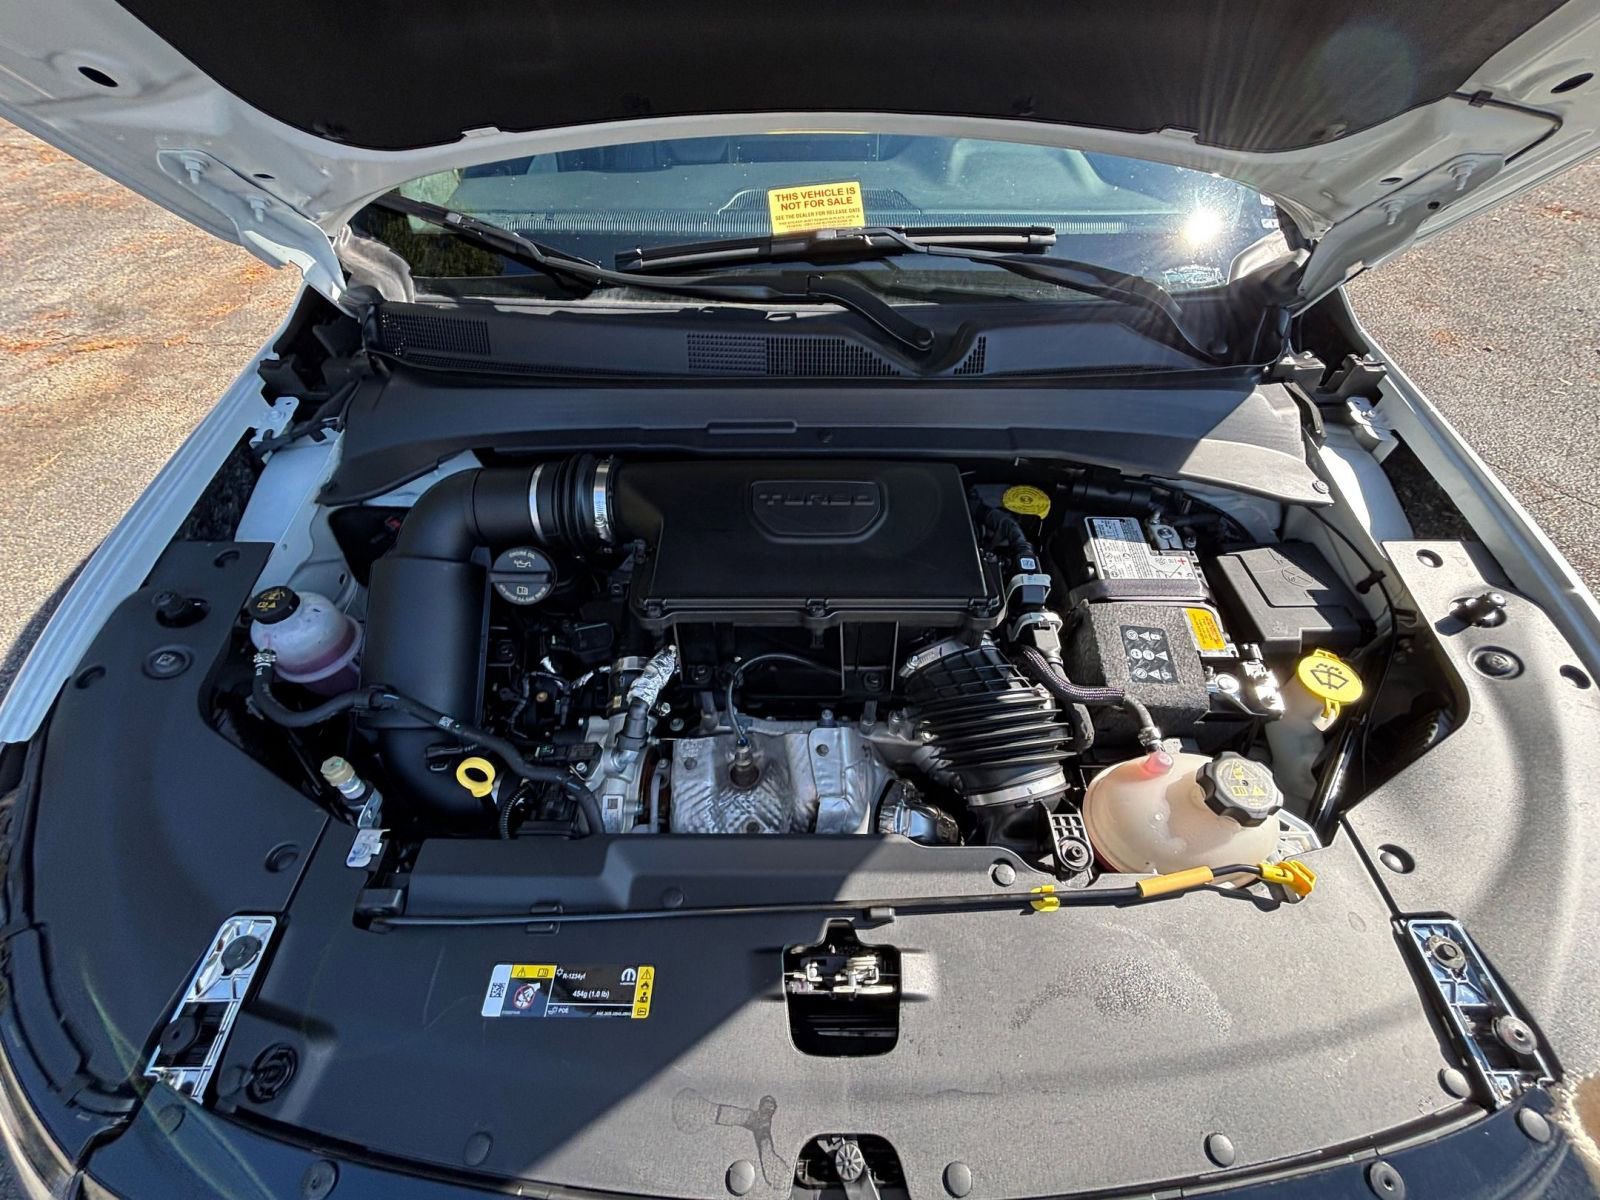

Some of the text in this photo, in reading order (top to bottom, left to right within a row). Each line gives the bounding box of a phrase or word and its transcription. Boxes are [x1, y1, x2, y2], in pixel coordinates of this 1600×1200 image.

[775, 187, 856, 202] THIS VEHICLE IS
[780, 196, 853, 211] NOT FOR SALE
[572, 990, 588, 999] 454g
